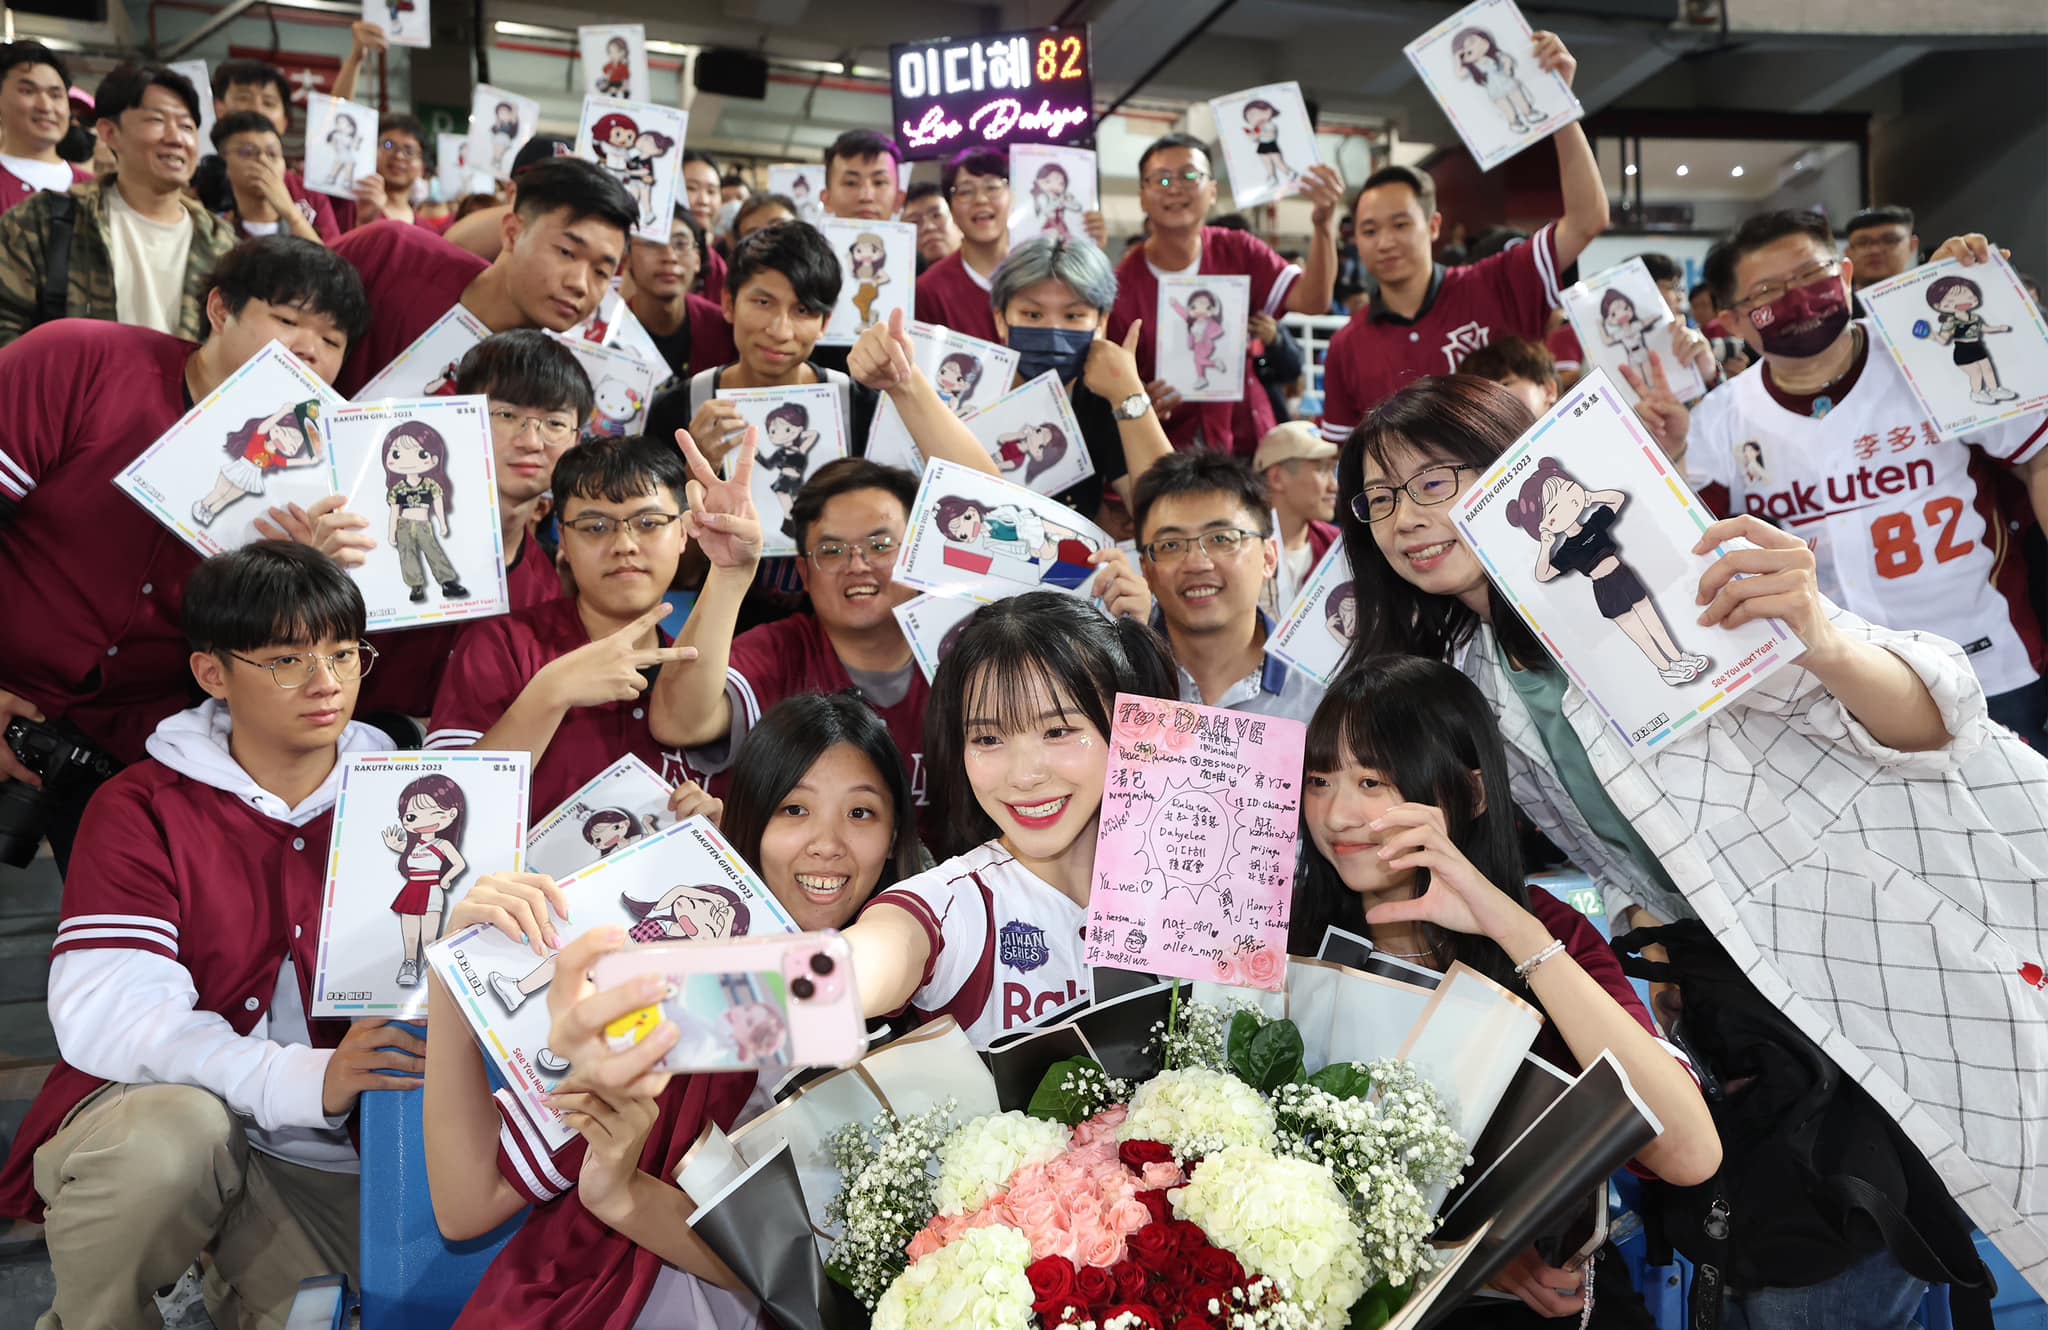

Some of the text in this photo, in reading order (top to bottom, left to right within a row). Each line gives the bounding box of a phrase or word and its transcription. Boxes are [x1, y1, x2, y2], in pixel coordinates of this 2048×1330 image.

[899, 36, 1082, 98] 이다혜 82
[333, 414, 370, 424] RAKUTEN
[1465, 455, 1532, 524] RAKUTEN GIRLS 2023
[1745, 458, 1935, 519] Rakuten
[1870, 496, 1975, 580] 82
[1280, 620, 1302, 648] RAKUTEN
[1711, 675, 1728, 688] See
[1725, 666, 1741, 679] You
[1754, 637, 1778, 656] Year!
[1174, 708, 1266, 745] DAHYE
[354, 763, 443, 772] RAKUTEN GIRLS 2023
[527, 828, 550, 849] AKUTEN
[690, 828, 753, 899] RAKUTEN GIRLS 2023
[1573, 891, 1600, 914] 12
[513, 1047, 526, 1063] See
[522, 1062, 535, 1080] You
